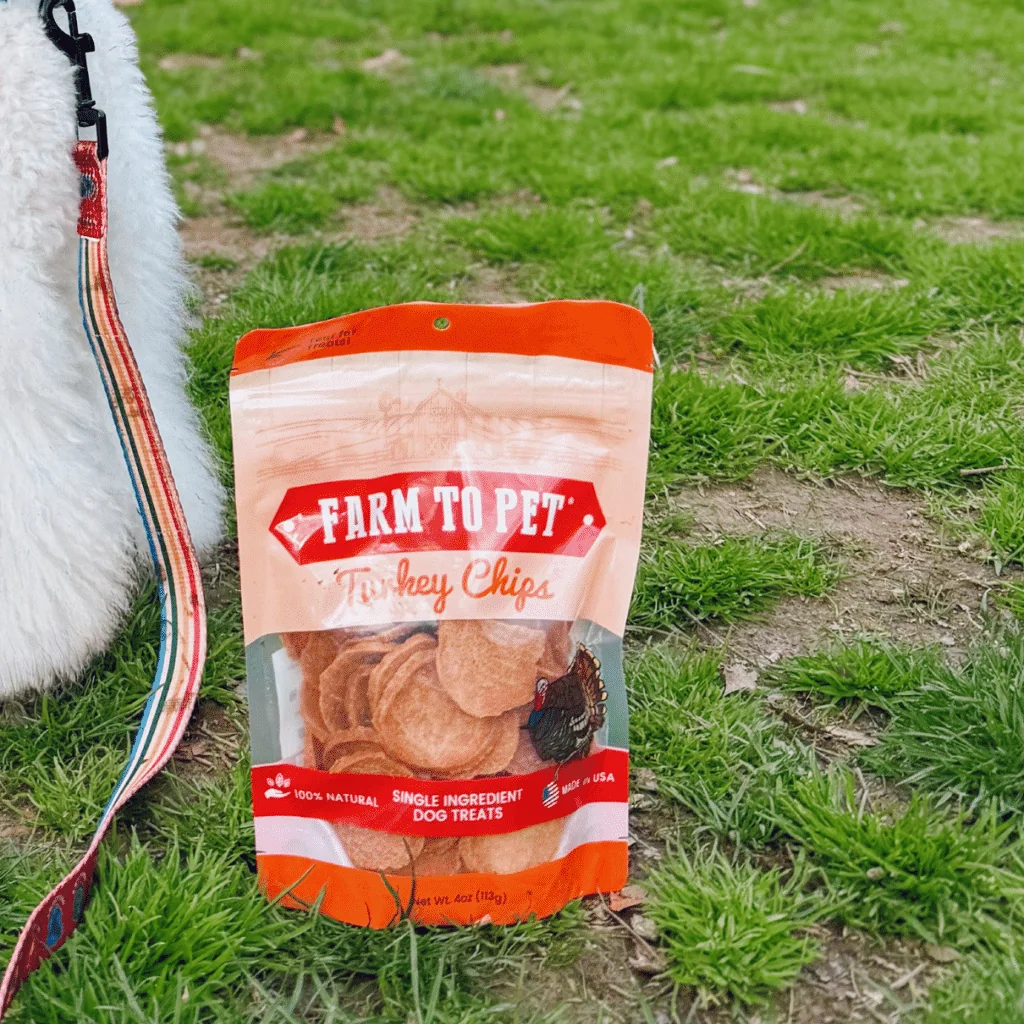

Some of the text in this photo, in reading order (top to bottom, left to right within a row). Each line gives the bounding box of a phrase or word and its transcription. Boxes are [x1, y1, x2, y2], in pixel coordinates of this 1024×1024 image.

[318, 487, 423, 544] FARM
[434, 486, 483, 532] TO
[335, 556, 555, 615] Turkey Chips
[561, 778, 581, 795] MADE
[592, 771, 615, 783] USA
[294, 789, 379, 808] 100% NATURAL
[392, 788, 524, 808] SINGLE INGREDIENT
[413, 807, 503, 822] DOG TREATS
[476, 889, 507, 906] (113g)
